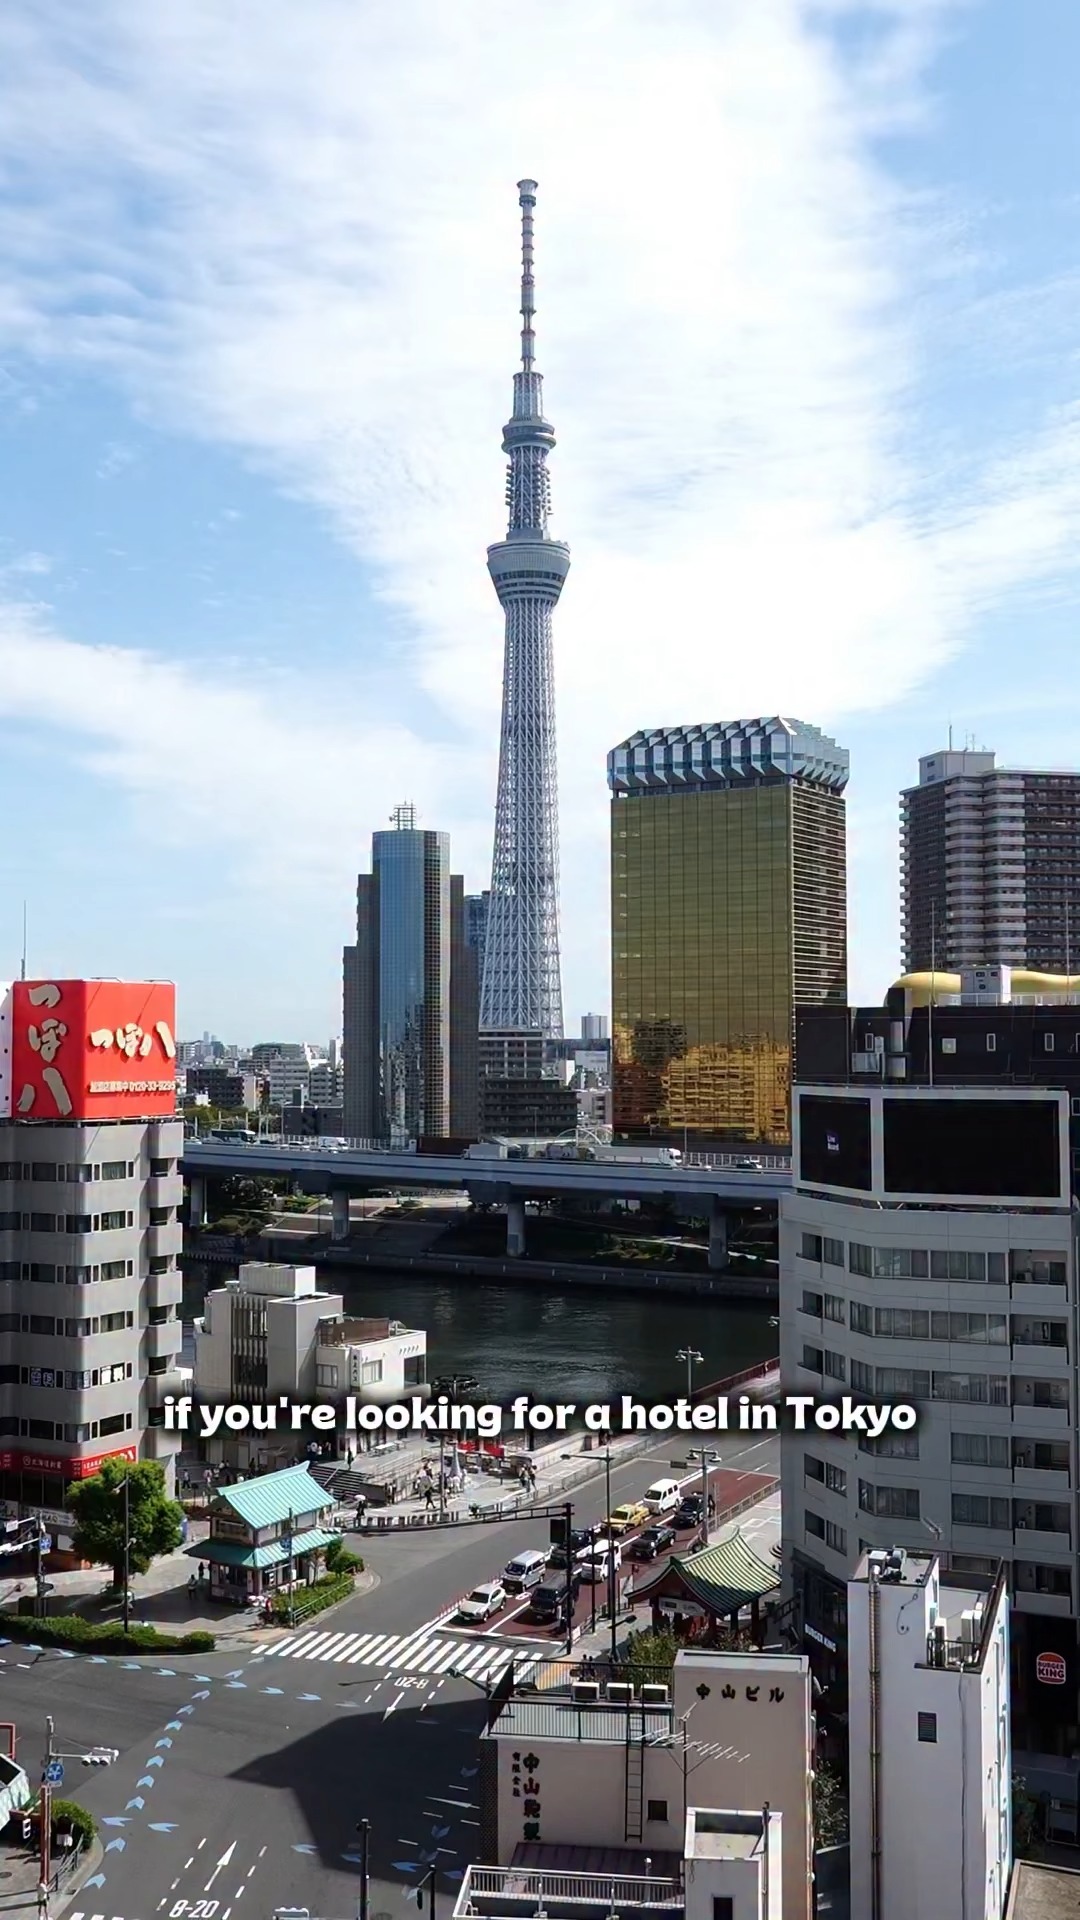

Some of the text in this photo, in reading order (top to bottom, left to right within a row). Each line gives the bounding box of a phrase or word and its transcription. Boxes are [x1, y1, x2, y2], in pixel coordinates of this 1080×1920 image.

[16, 984, 73, 1116] つぼ八
[90, 1021, 176, 1059] つぼ八
[1038, 1661, 1064, 1670] BURGER
[1038, 1667, 1064, 1679] KING
[393, 1676, 430, 1689] 8-20
[696, 1683, 785, 1703] 中山ビル
[168, 1899, 221, 1919] 8-20
